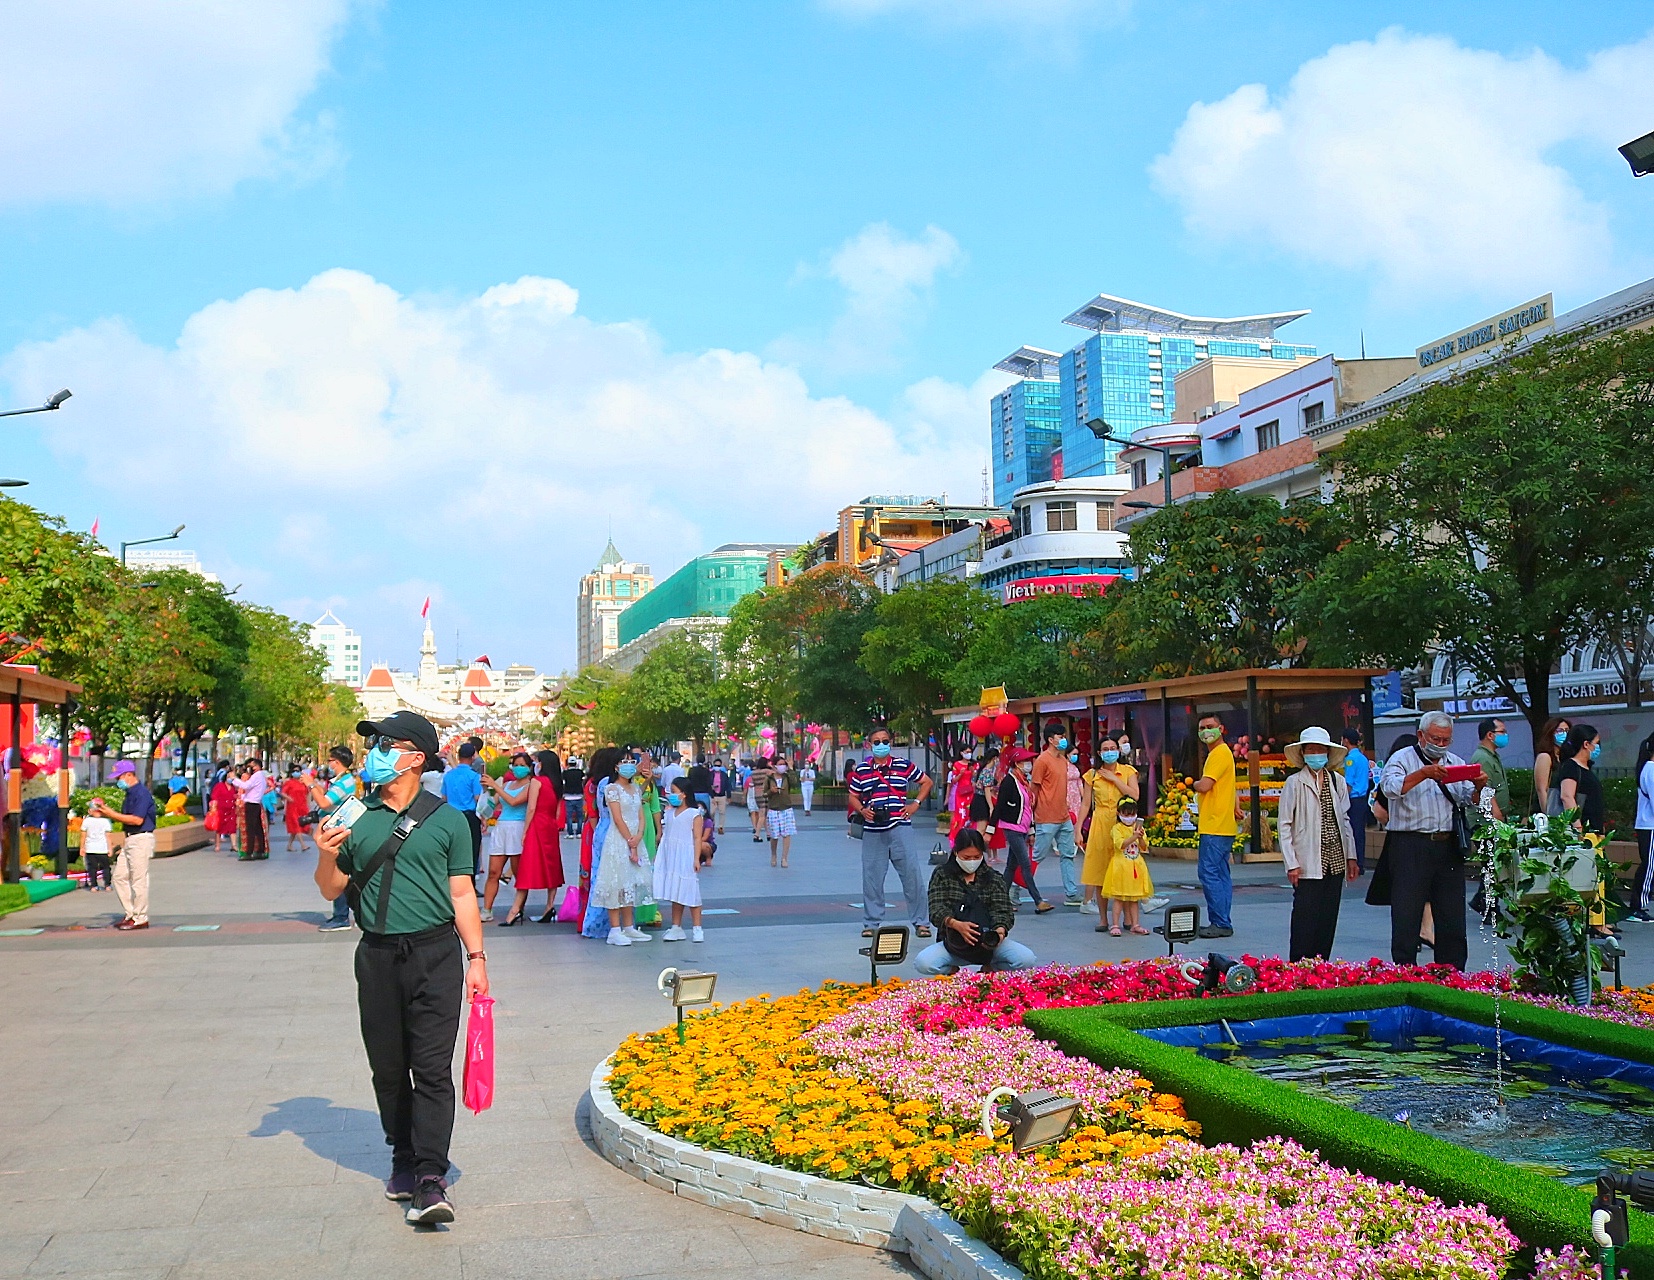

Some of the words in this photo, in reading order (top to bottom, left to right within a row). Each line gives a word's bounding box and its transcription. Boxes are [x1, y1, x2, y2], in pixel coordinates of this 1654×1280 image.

[1419, 341, 1455, 367] OSCAR
[1457, 325, 1495, 353] HOTEL
[1498, 302, 1548, 335] SAIGON
[1602, 682, 1645, 696] HOTL
